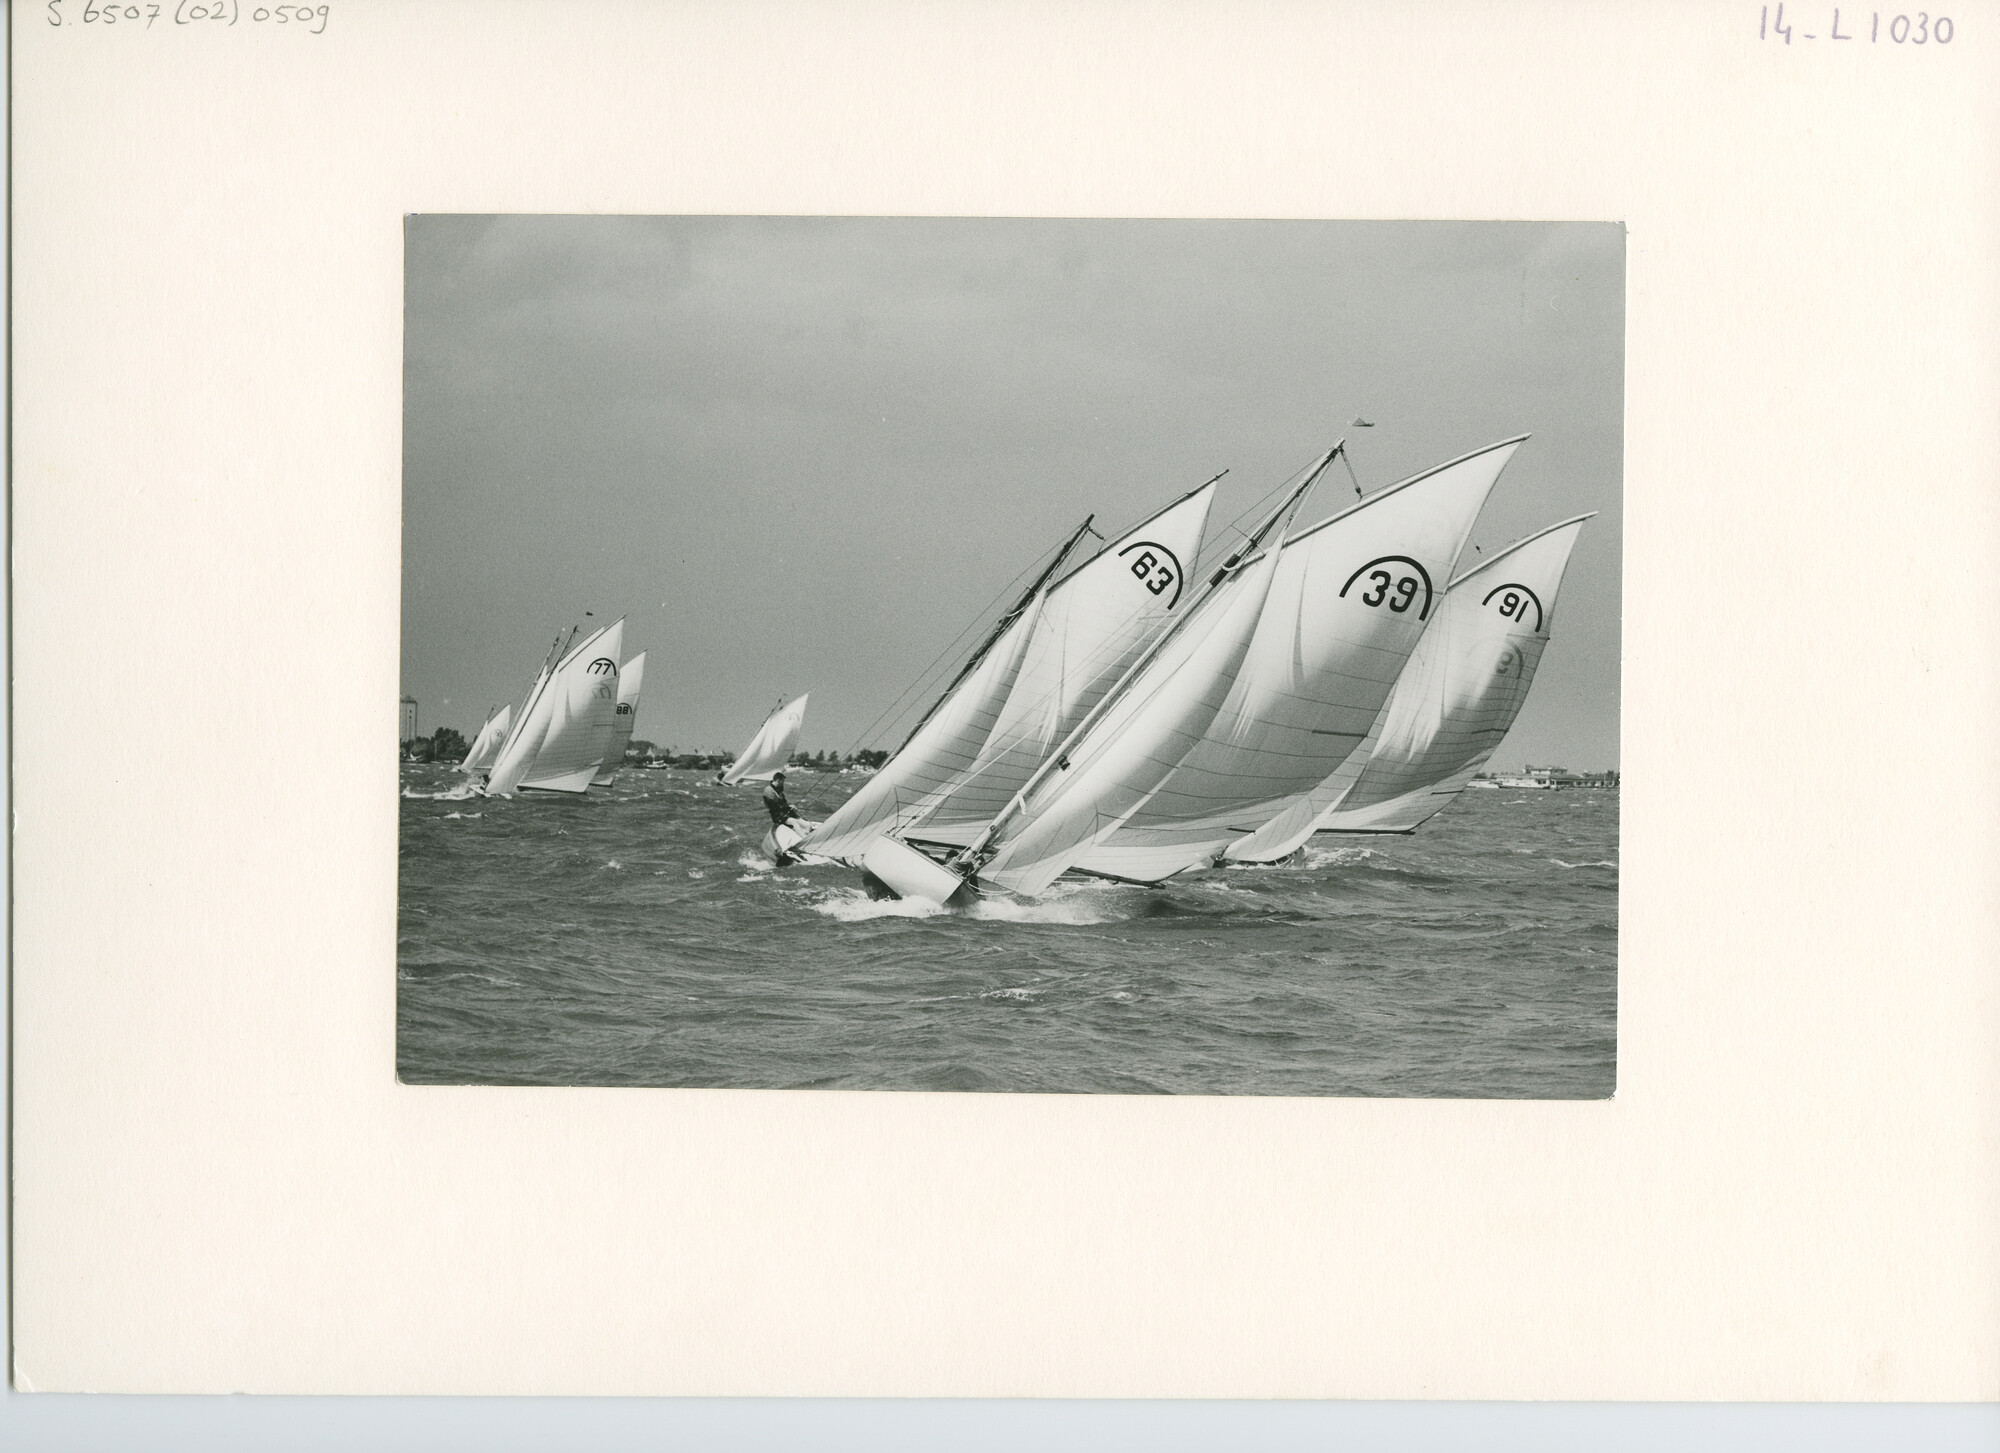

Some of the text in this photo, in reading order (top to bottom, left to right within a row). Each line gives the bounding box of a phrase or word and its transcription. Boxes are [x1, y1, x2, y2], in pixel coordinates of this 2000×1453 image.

[83, 0, 161, 30] 6507
[174, 0, 239, 27] (02)
[252, 5, 330, 34] 0509
[1131, 551, 1174, 595] 63
[1362, 569, 1419, 614] 39
[1498, 591, 1530, 623] 91
[595, 662, 611, 675] 77
[616, 705, 629, 714] 88
